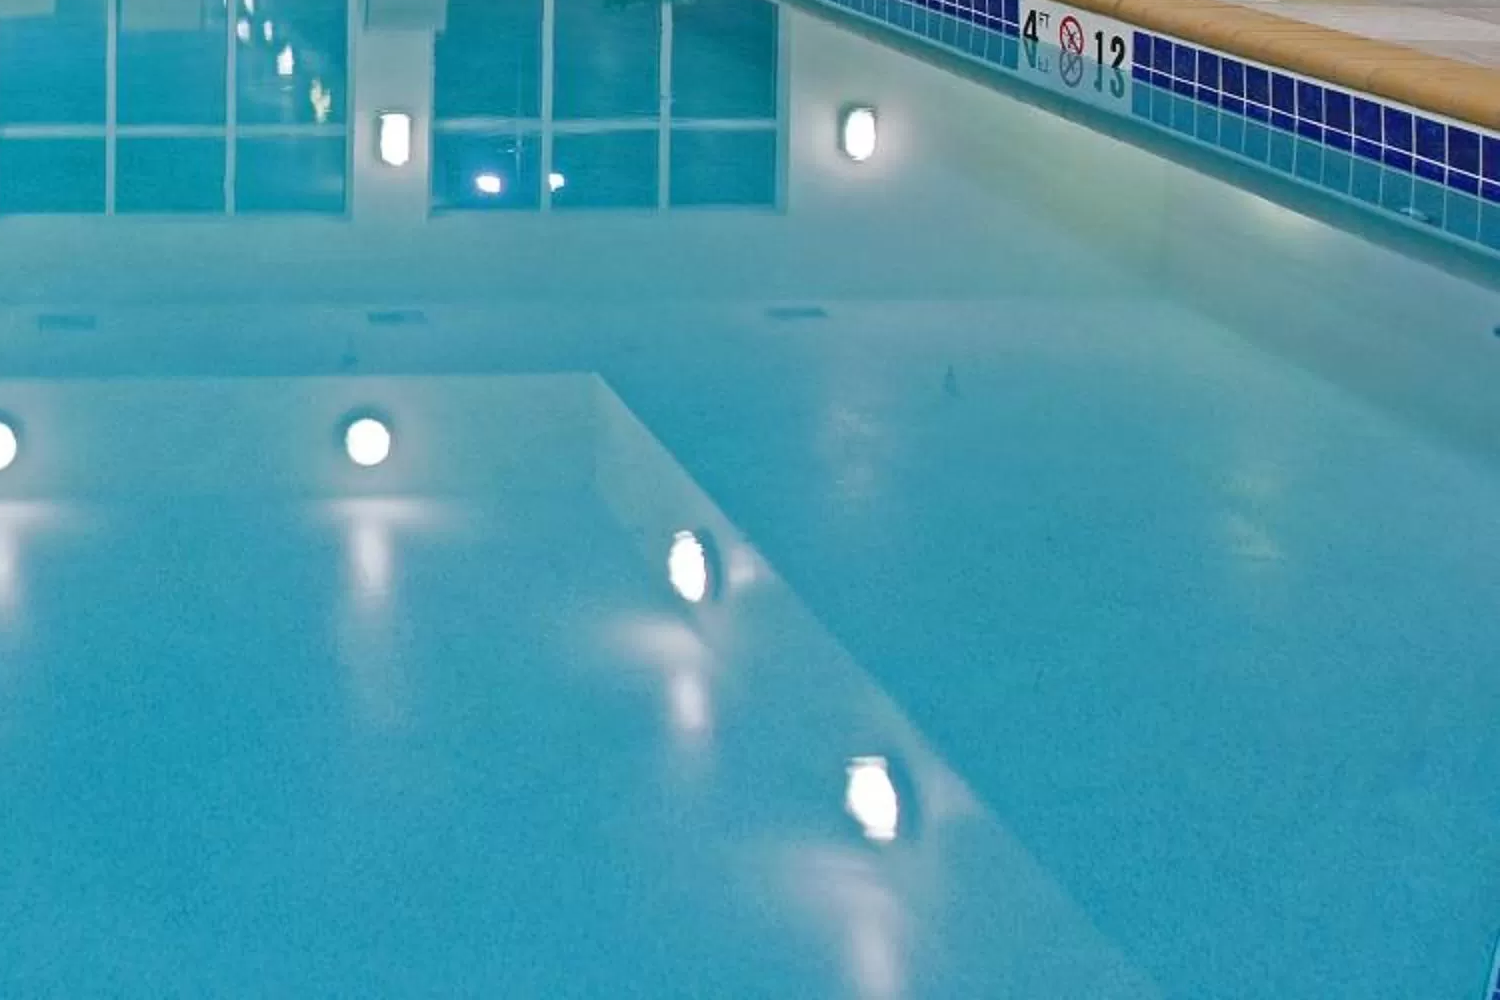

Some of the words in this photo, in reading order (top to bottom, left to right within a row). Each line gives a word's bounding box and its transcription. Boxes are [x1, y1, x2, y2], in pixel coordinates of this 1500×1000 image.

[1023, 9, 1039, 42] 4
[1039, 12, 1050, 28] FT
[1094, 30, 1126, 69] 12
